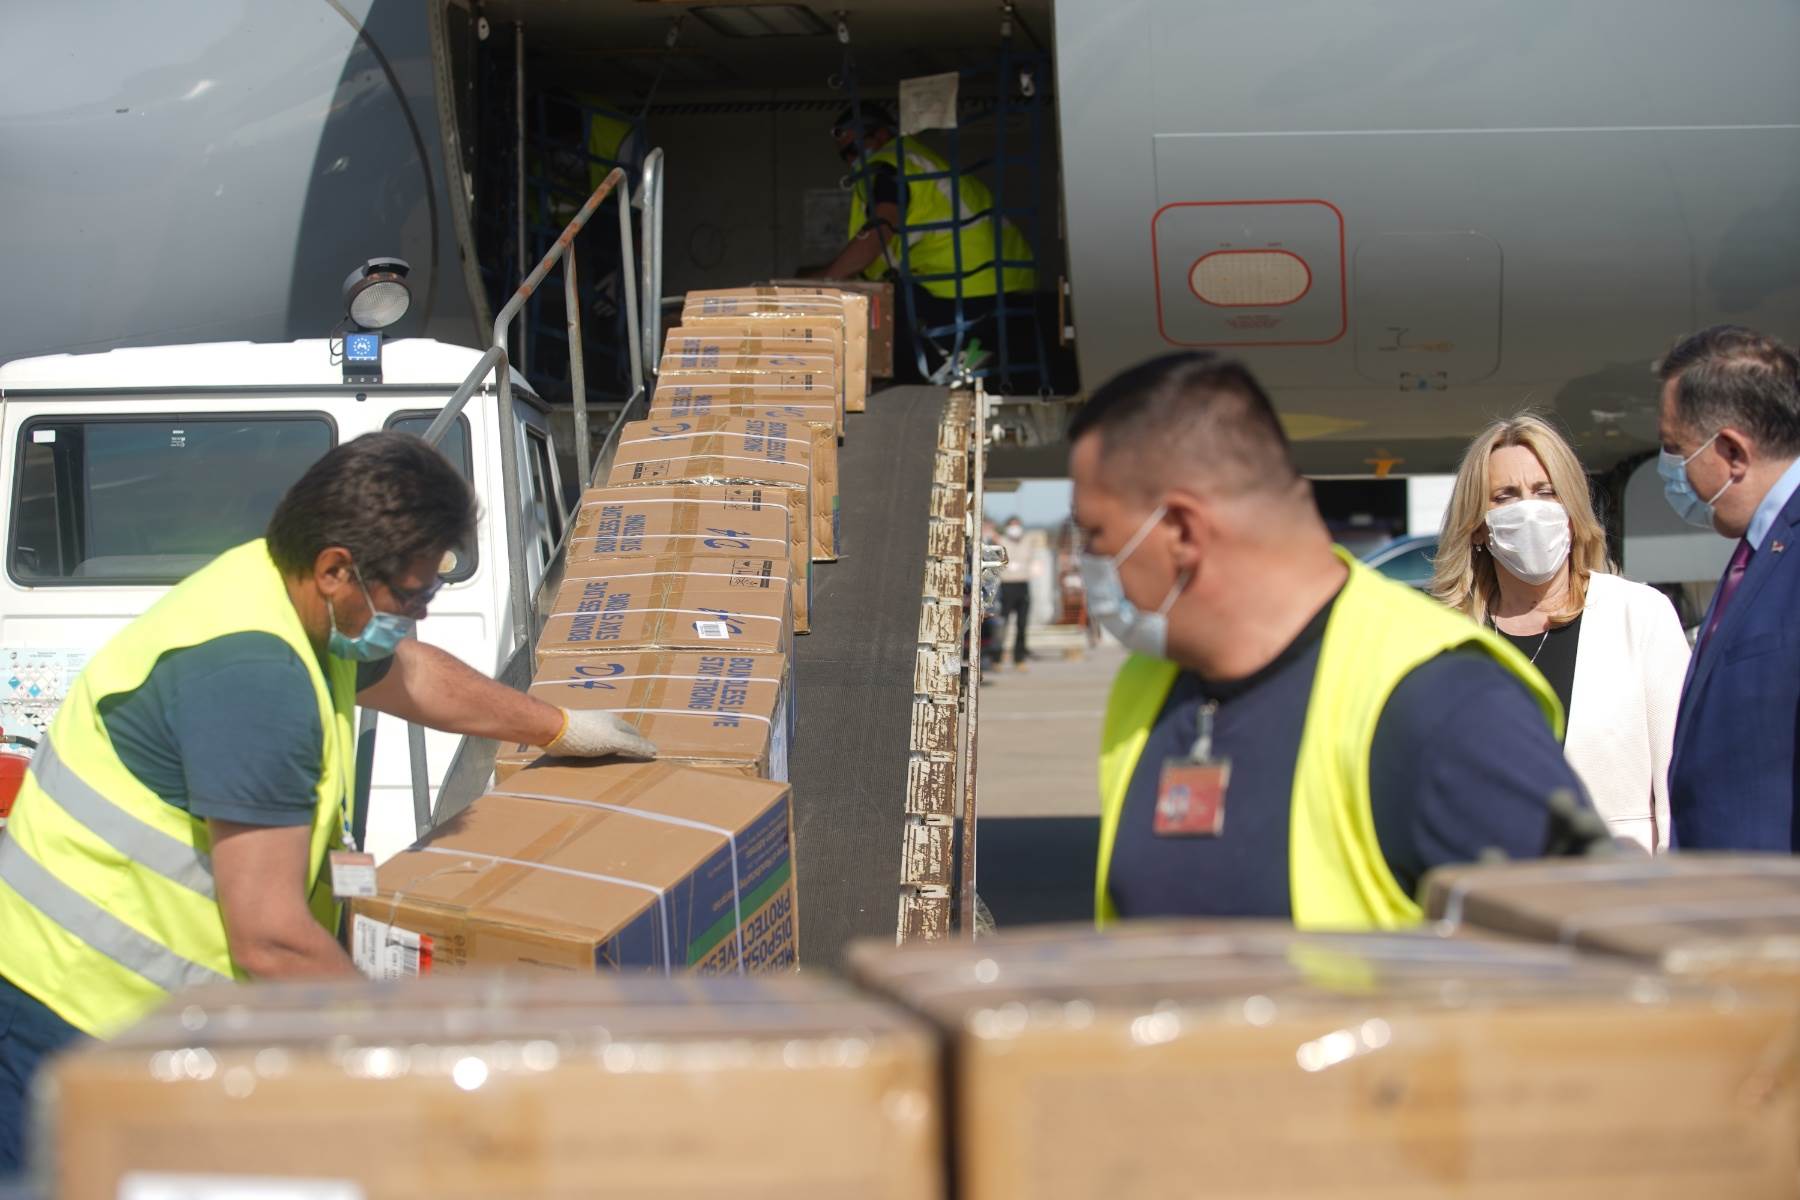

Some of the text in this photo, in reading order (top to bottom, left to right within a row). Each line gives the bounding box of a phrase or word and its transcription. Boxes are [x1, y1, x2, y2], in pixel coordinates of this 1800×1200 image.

[568, 582, 608, 642] BOUNDESS LOVE
[595, 593, 632, 640] STAY STRONG
[697, 656, 724, 675] STAY
[719, 657, 754, 705] BOUNDLESS
[688, 676, 720, 710] STRONG
